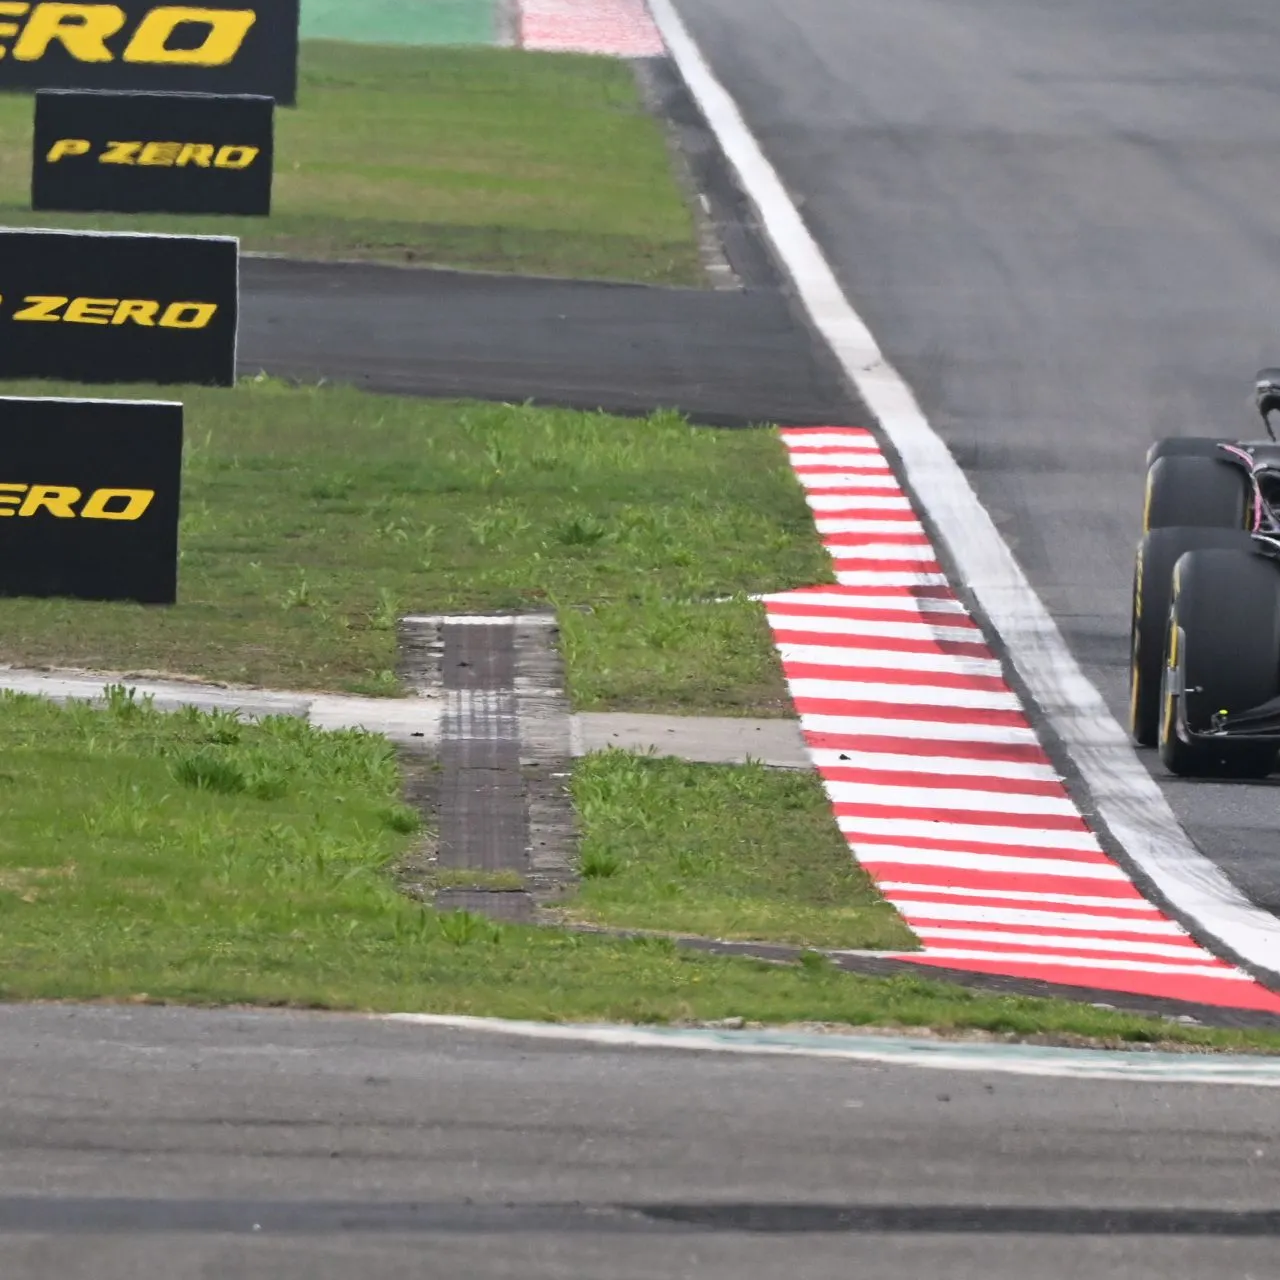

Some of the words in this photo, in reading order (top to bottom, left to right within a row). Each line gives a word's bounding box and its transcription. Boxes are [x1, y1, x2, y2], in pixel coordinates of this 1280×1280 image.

[46, 138, 91, 163] P
[98, 140, 260, 169] ZERO
[12, 295, 218, 329] ZERO
